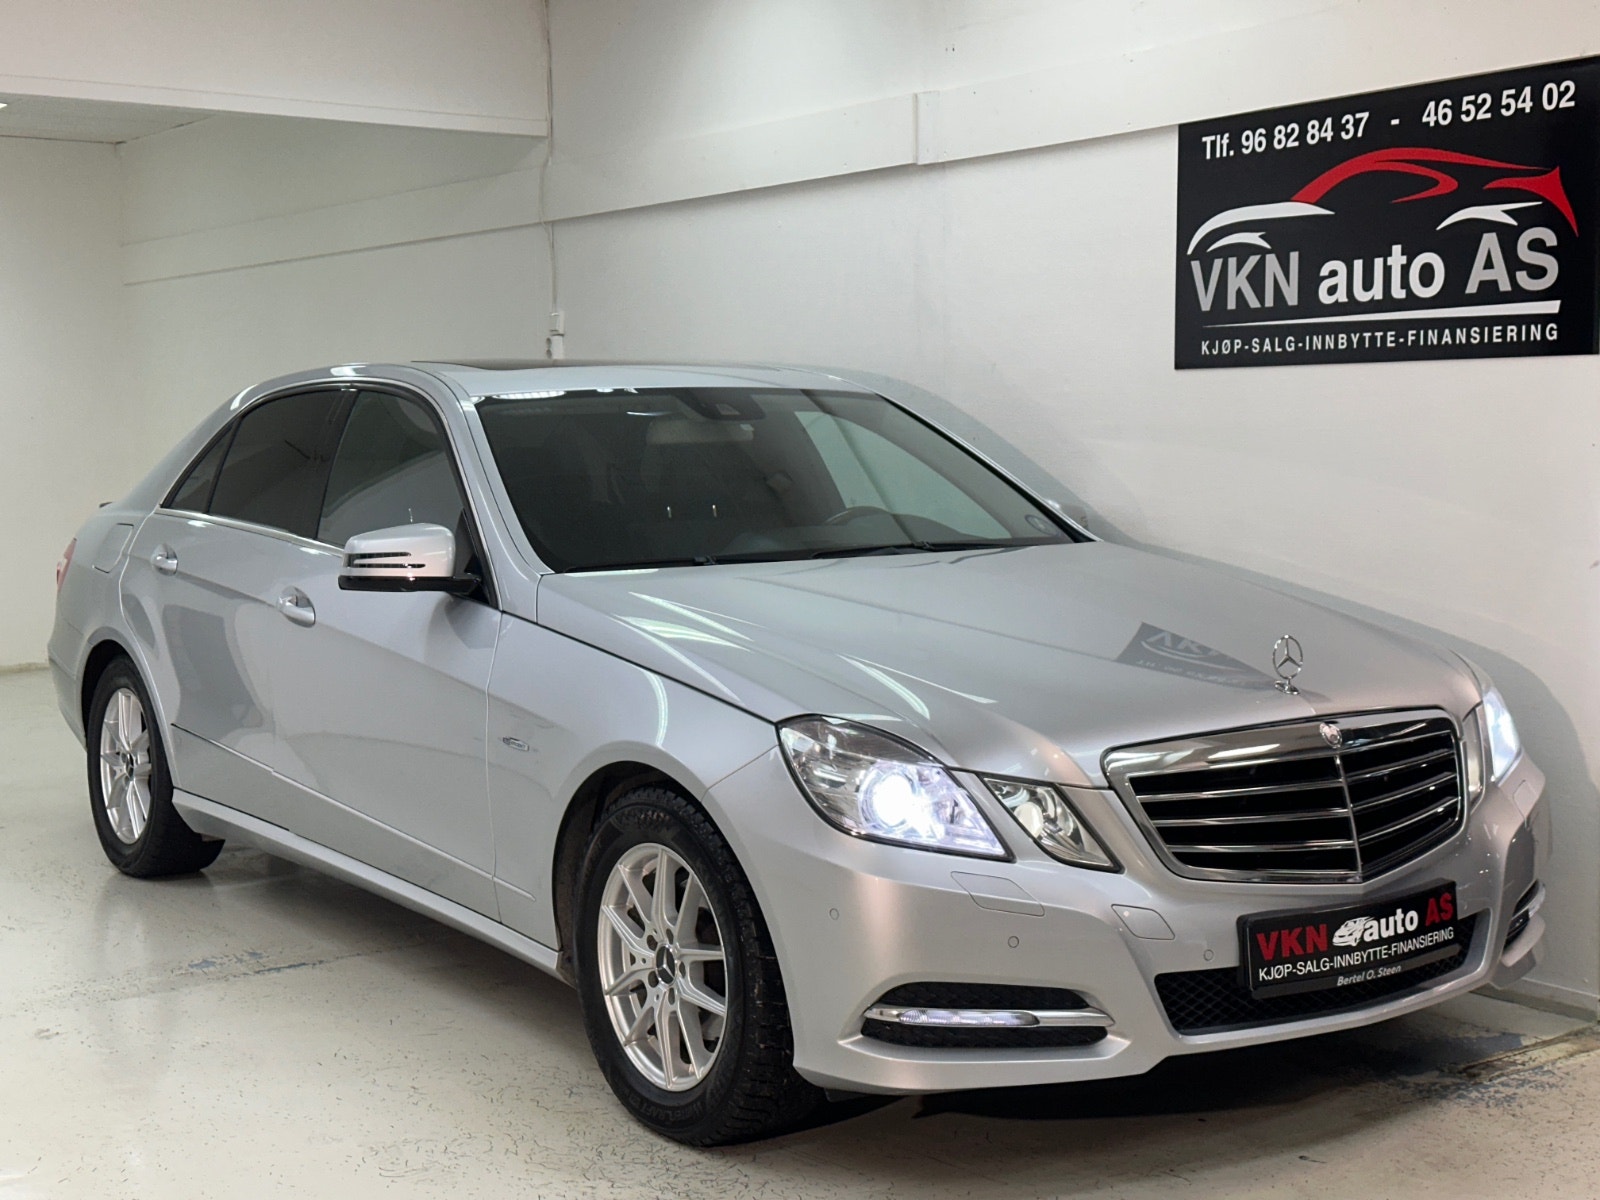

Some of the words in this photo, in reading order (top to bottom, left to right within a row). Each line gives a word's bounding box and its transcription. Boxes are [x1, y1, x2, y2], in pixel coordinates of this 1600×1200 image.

[1202, 133, 1235, 160] Tlf.
[1241, 127, 1267, 155] 96
[1273, 122, 1300, 150] 82
[1306, 117, 1334, 145] 84
[1340, 111, 1370, 140] 37
[1421, 98, 1453, 127] 46
[1460, 93, 1492, 123] 52
[1500, 86, 1533, 117] 54
[1542, 80, 1576, 111] 02
[1190, 251, 1300, 312] VKN
[1318, 244, 1445, 305] auto
[1465, 226, 1559, 294] AS
[1201, 323, 1558, 356] KJØP-SALG-INNBYTTE-FINANSIERING
[1257, 924, 1328, 960] VKN
[1363, 908, 1418, 941] auto
[1425, 893, 1453, 926] AS
[1258, 926, 1455, 982] KJØP-SALG-INNBYTTE-FINANSIERING
[1336, 971, 1366, 987] Bertel
[1366, 969, 1377, 980] O.
[1377, 965, 1402, 979] Steen
